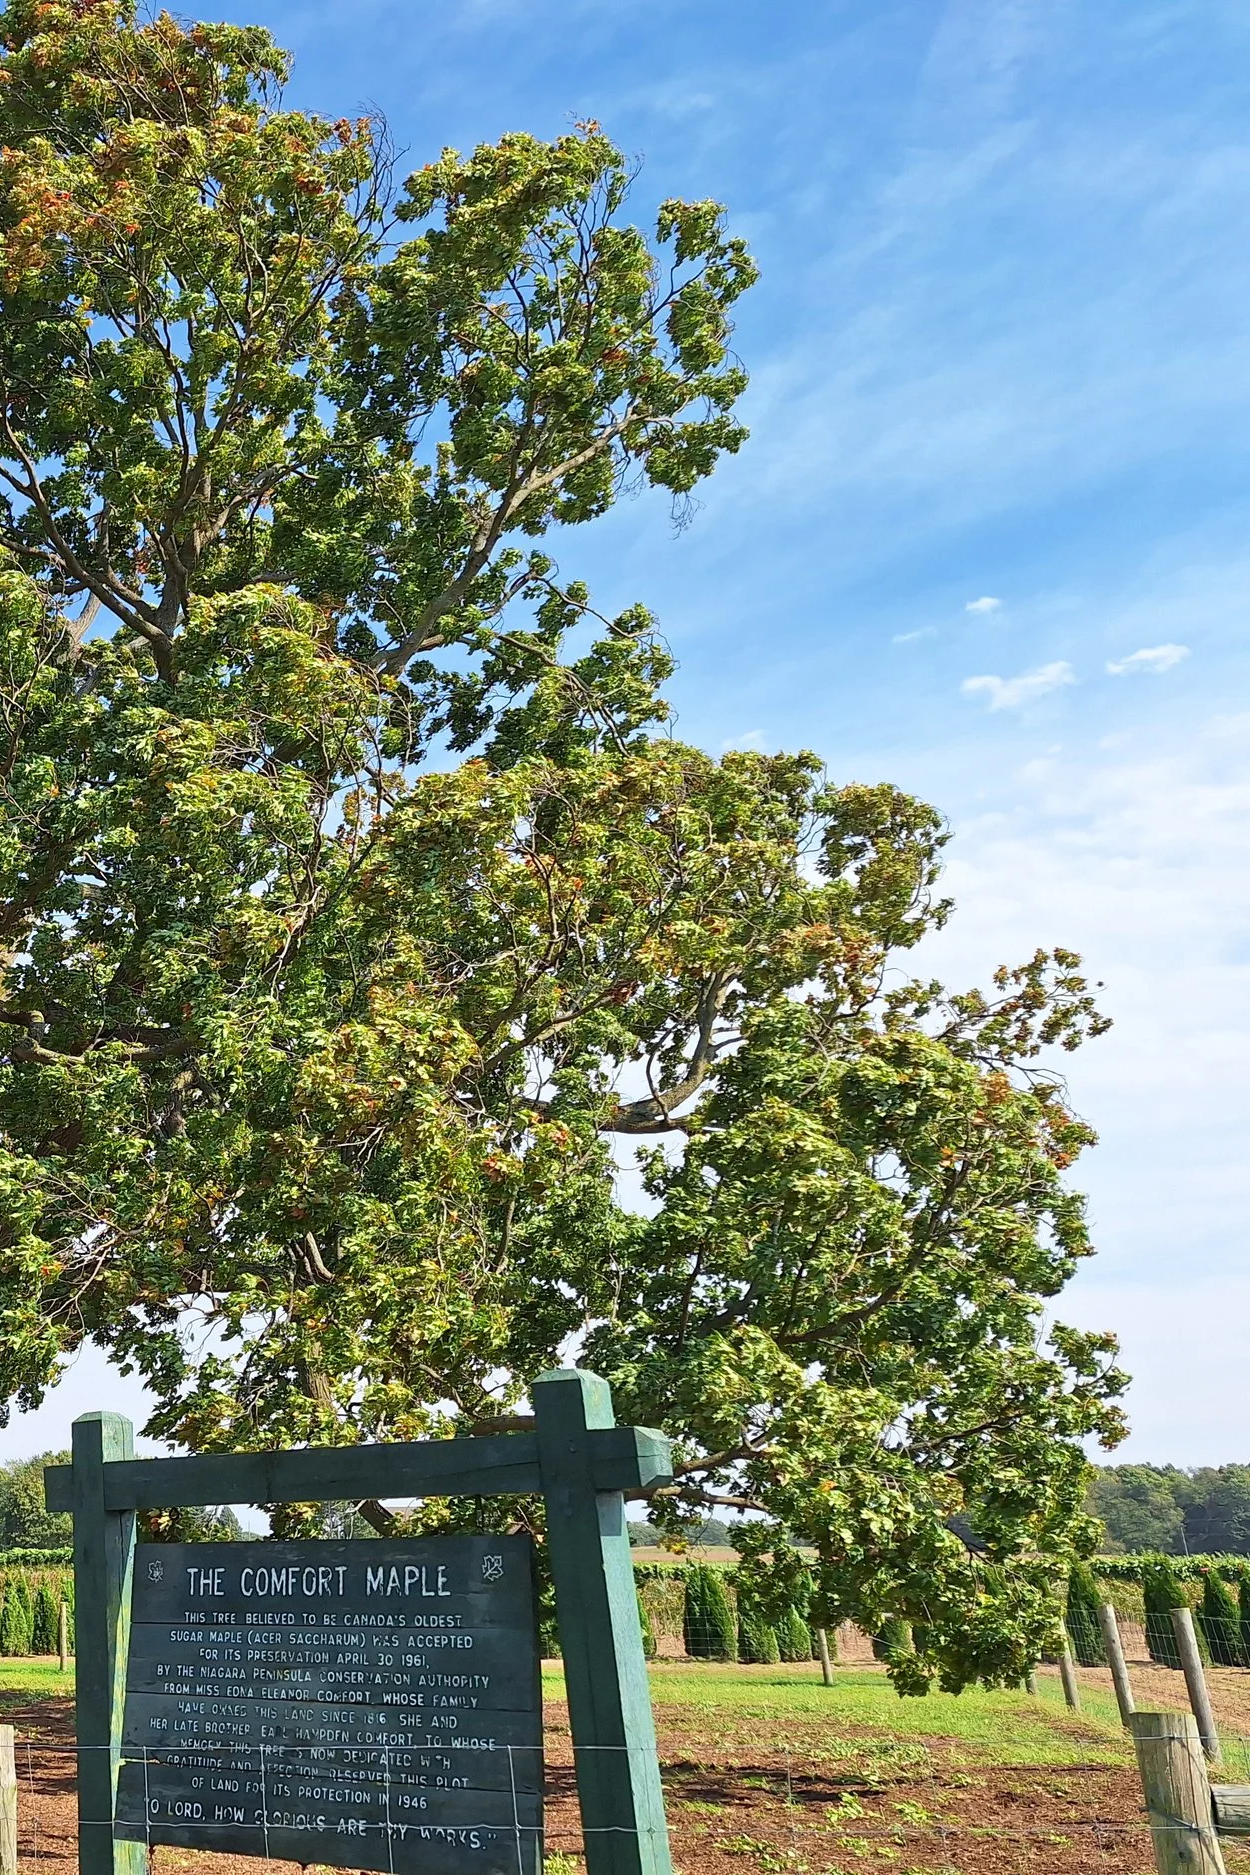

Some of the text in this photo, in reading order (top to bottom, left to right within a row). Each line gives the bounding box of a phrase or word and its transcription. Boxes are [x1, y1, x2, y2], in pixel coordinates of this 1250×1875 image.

[187, 1565, 451, 1598] THE COMFORT MAPLE
[184, 1611, 463, 1628] THIS TREE BELIEVED TO BE CANADA'S OLDEST
[170, 1629, 473, 1649] SUGAR MAPLE (ACER SACCHARUM) WAS ACCEPTED
[200, 1648, 430, 1670] FOR ITS PRESERVATION APRIL 30 1961,
[157, 1664, 490, 1689] BY THE NIAGARA PENINSULA CONSERVATION AUTHORITY
[164, 1682, 190, 1695] FROM
[196, 1684, 219, 1696] MISS
[226, 1685, 253, 1698] EDNA
[261, 1687, 309, 1701] ELEANOR
[383, 1692, 425, 1706] WHOSE
[432, 1694, 478, 1708] FAMILY
[178, 1701, 457, 1729] HAVE OWNED THIS LAND SINCE 1816 SHE AND
[150, 1717, 168, 1730] HER
[174, 1719, 199, 1732] LATE
[295, 1727, 350, 1743] HAMPDEN
[425, 1734, 443, 1748] TO
[451, 1736, 497, 1751] WHOSE
[180, 1738, 222, 1751] MEMORY
[229, 1740, 251, 1754] THIS
[258, 1743, 284, 1758] TREE
[310, 1748, 336, 1761] NOW
[343, 1750, 412, 1766] DEDICATED
[420, 1754, 451, 1770] WTH
[166, 1754, 470, 1791] GRATITUDE AND FFECION RESERVED THIS PLOT
[191, 1776, 428, 1809] OF LAND FOR ITS PROTECTION IN 1946
[167, 1800, 206, 1821] LORD,
[214, 1804, 245, 1823] HOW
[254, 1809, 327, 1833] GLORIOUS
[336, 1818, 368, 1837] ARE
[420, 1826, 497, 1850] WORKS."
